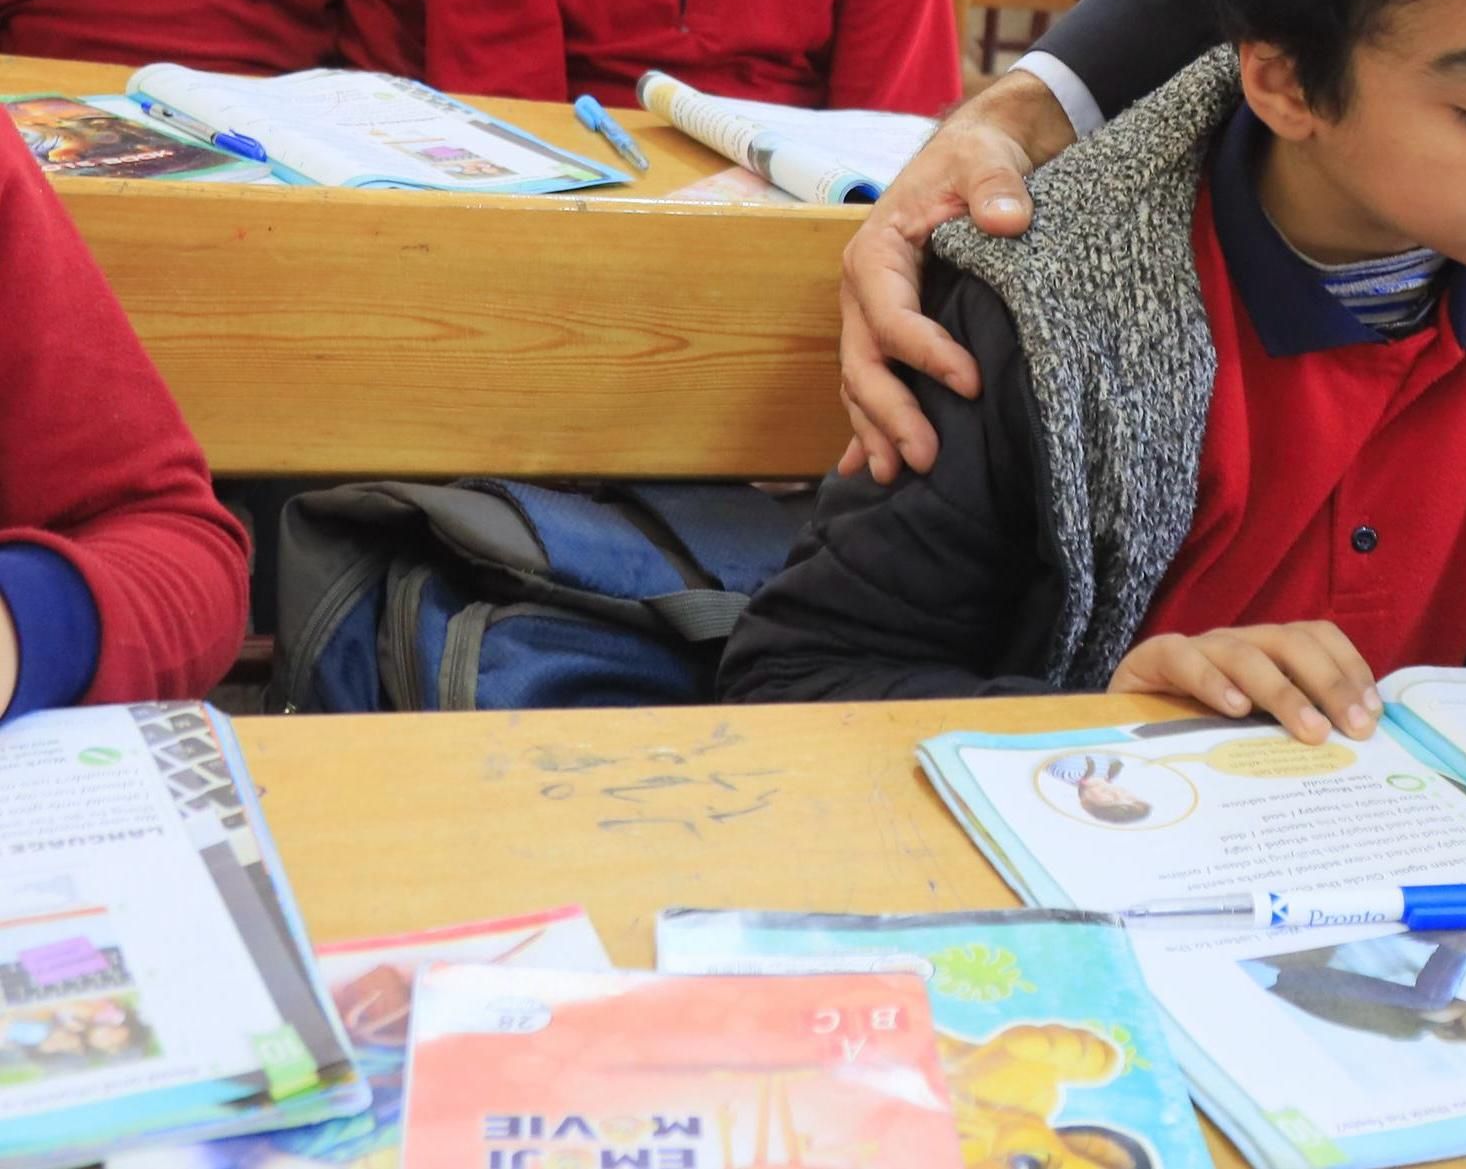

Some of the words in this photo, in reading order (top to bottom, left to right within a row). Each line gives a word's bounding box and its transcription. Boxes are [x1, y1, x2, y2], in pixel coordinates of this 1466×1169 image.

[8, 827, 163, 856] LANGUAGE
[1308, 909, 1387, 930] Pronto
[811, 1007, 841, 1035] C
[870, 1007, 899, 1031] B
[840, 1035, 867, 1065] A
